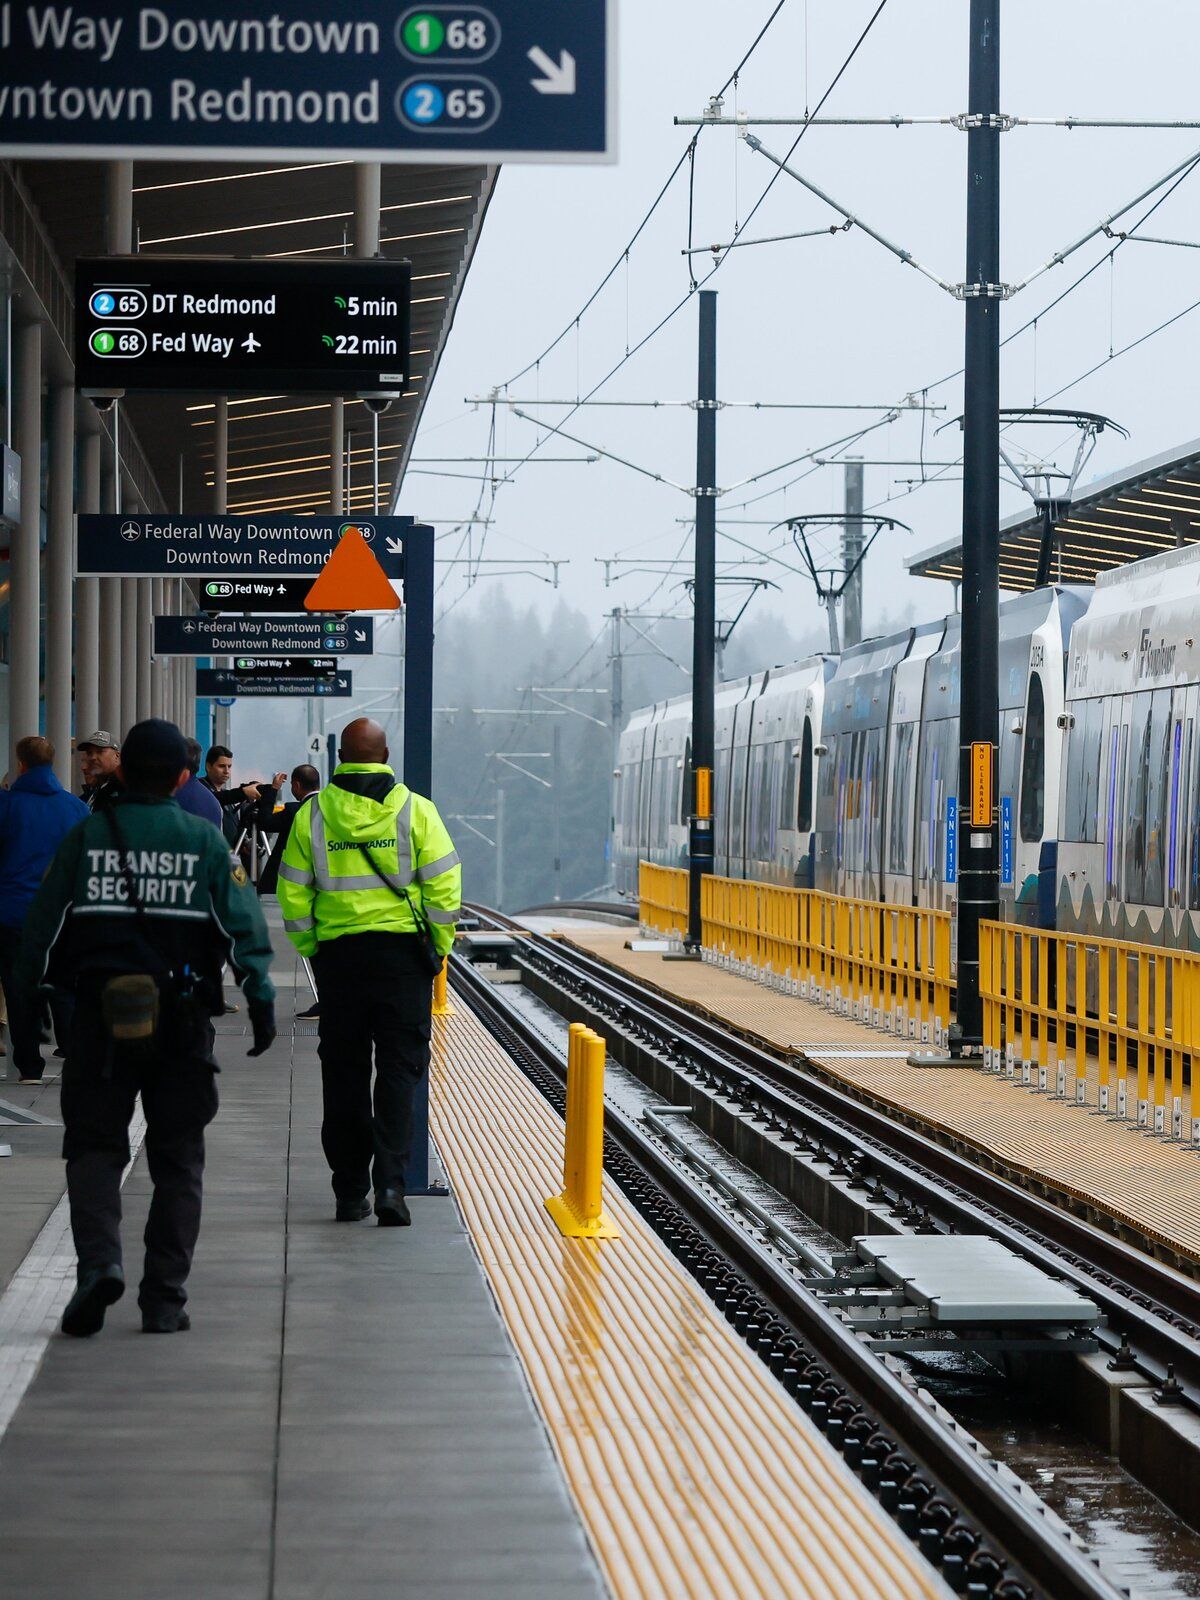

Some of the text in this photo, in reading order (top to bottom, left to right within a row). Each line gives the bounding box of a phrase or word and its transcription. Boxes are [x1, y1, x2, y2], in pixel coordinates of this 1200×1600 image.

[27, 6, 123, 62] Way
[139, 8, 380, 54] Downtown
[414, 19, 430, 49] 1
[446, 19, 487, 50] 68
[171, 77, 380, 124] Redmond
[414, 89, 434, 119] 2
[446, 88, 486, 120] 65
[99, 294, 398, 316] 2 65 DT Redmond 5 min
[100, 333, 397, 358] 1 68 Fed Way 22 min
[145, 523, 203, 540] Federal
[208, 524, 242, 545] Way
[247, 524, 333, 541] Downtown
[166, 548, 333, 565] Downtown Redmond
[219, 586, 230, 594] 68
[235, 583, 250, 594] Fed
[253, 584, 274, 598] Way
[198, 621, 237, 633] Federal
[240, 621, 262, 636] Way
[264, 621, 321, 633] Downtown
[335, 623, 346, 632] 68
[212, 637, 270, 650] Downtown
[271, 637, 321, 650] Redmond
[335, 639, 346, 648] 65
[256, 659, 269, 668] Fed
[269, 659, 284, 670] Way
[310, 737, 320, 753] 4
[87, 849, 200, 877] TRANSIT
